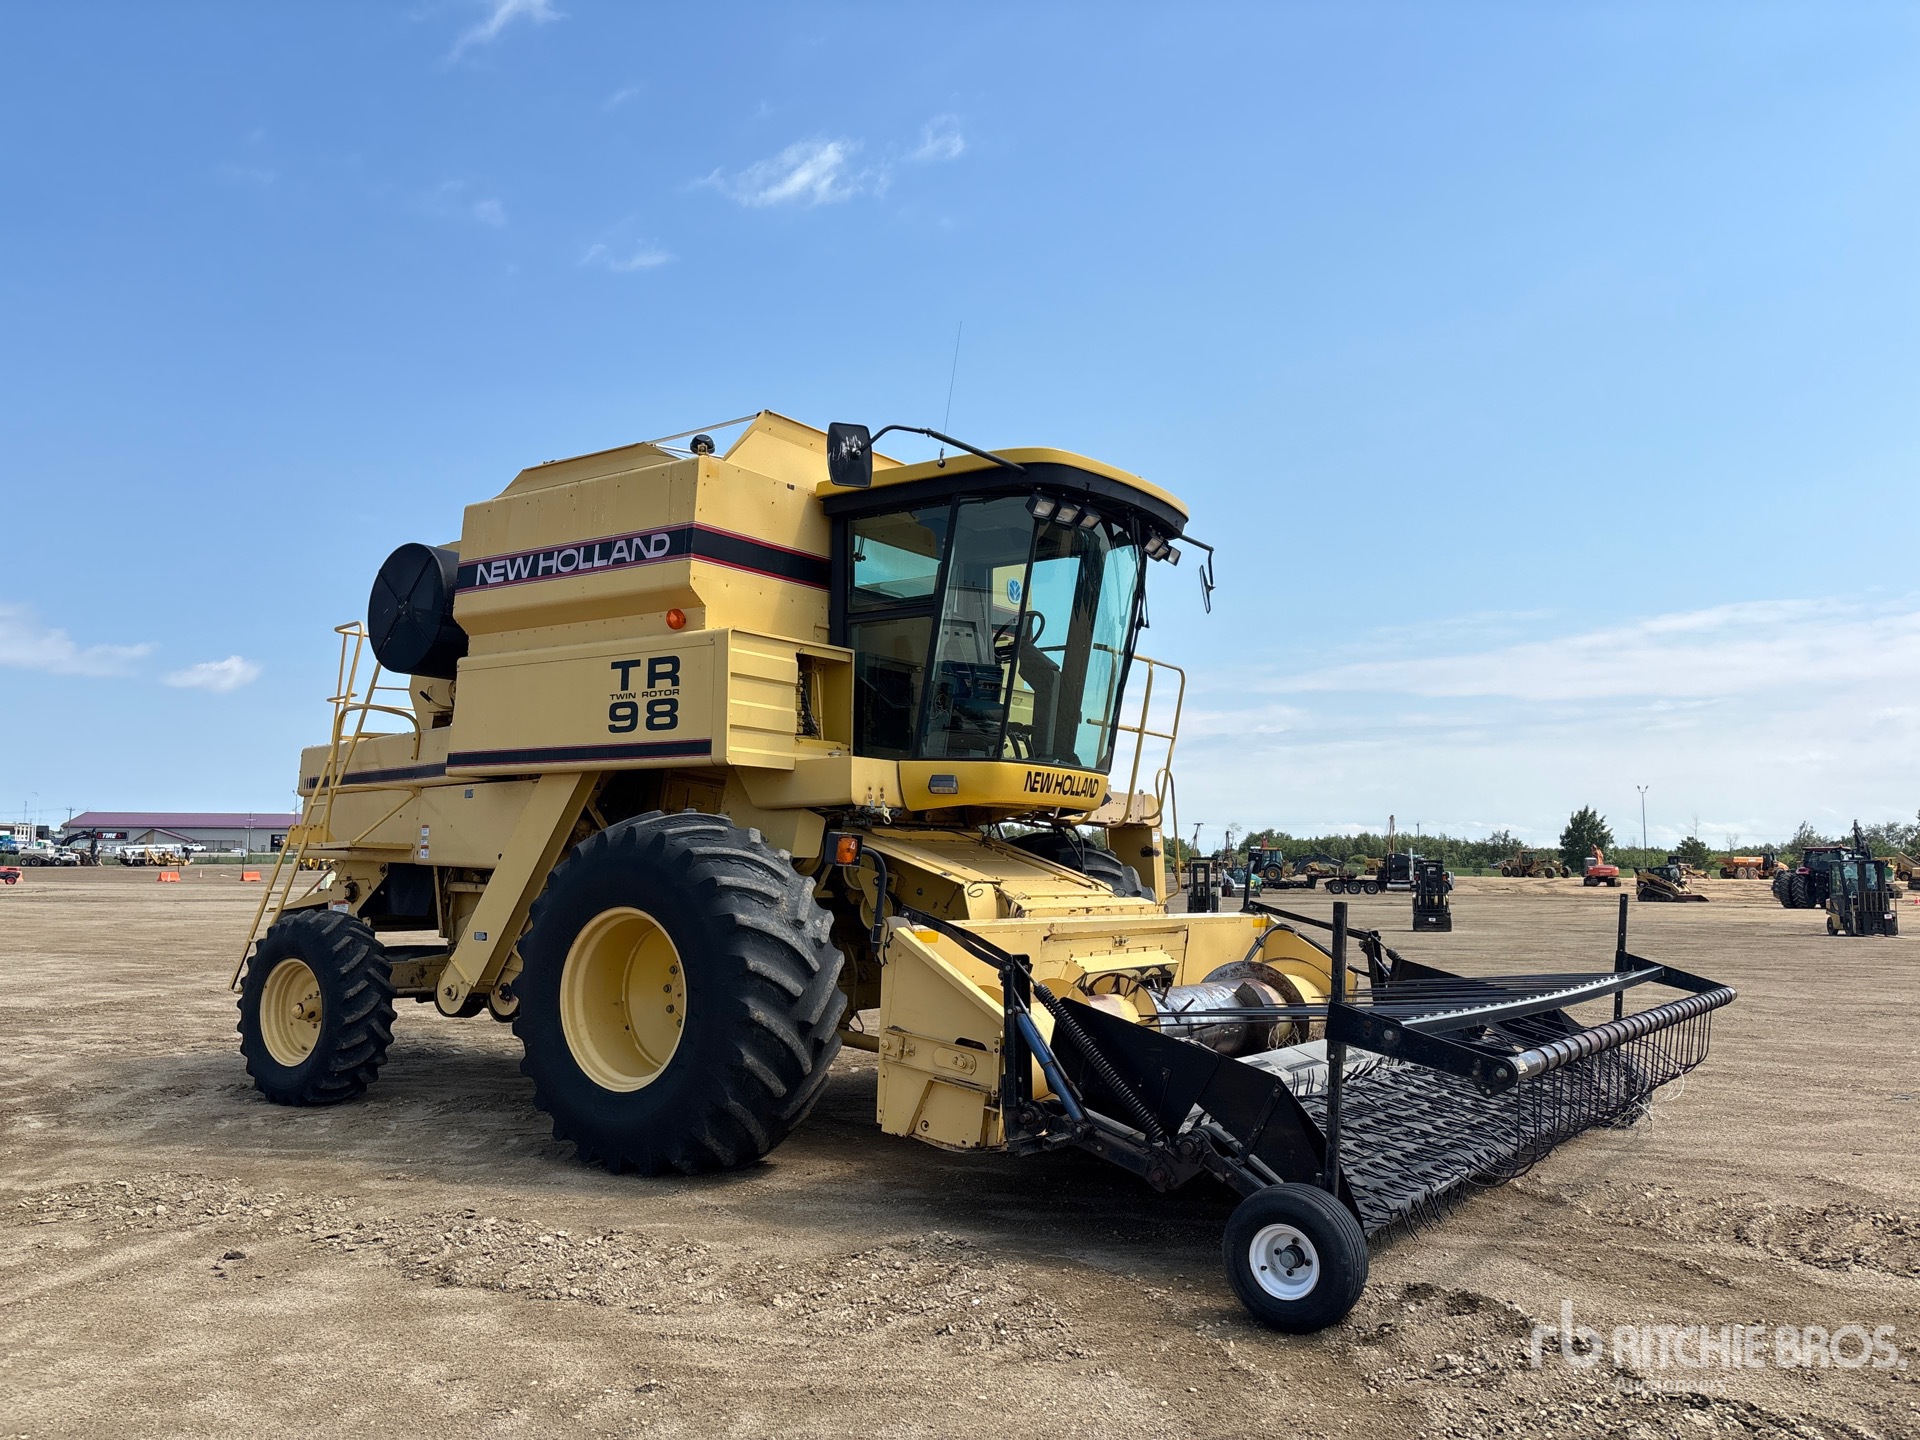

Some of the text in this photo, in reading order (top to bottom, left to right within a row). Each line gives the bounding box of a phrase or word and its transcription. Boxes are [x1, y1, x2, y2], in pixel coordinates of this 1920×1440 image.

[475, 533, 671, 586] NEW HOLLAND
[610, 655, 680, 691] TR
[609, 688, 680, 701] TWIN ROTOR
[608, 698, 679, 733] 98
[1024, 771, 1099, 798] NEW HOLLAND
